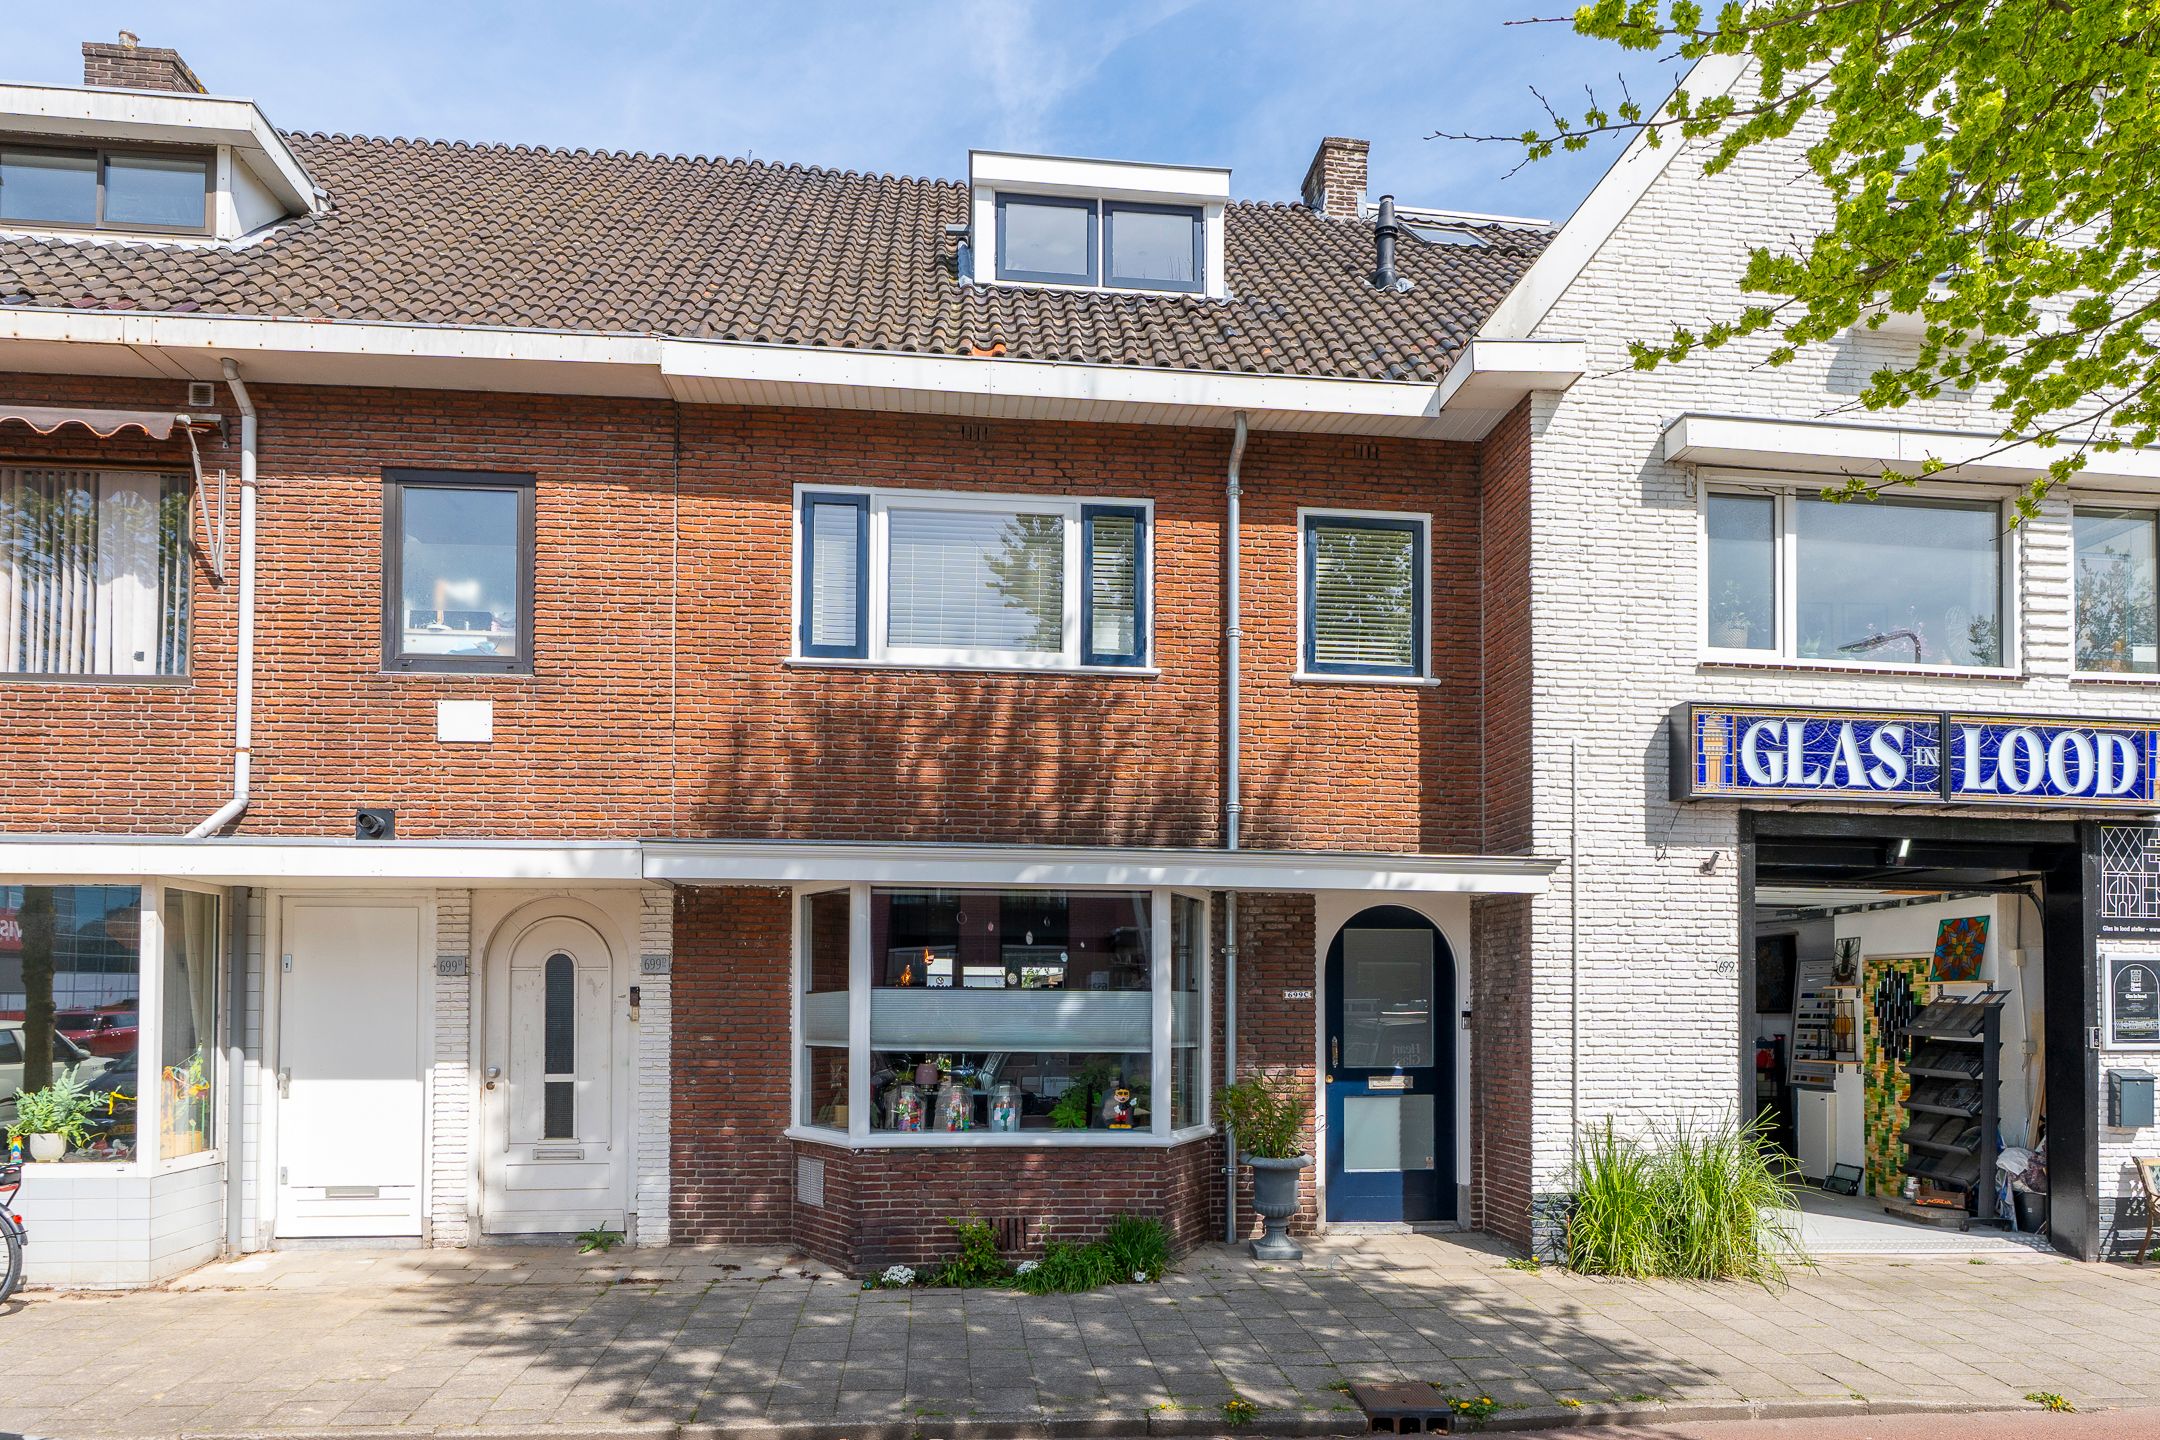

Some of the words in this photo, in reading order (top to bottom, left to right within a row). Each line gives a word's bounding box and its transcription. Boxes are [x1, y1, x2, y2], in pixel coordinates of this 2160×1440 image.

[1741, 720, 1907, 789] GLAS
[1914, 747, 1940, 766] IN
[1963, 727, 2138, 795] LOOD
[1719, 961, 1735, 973] 699
